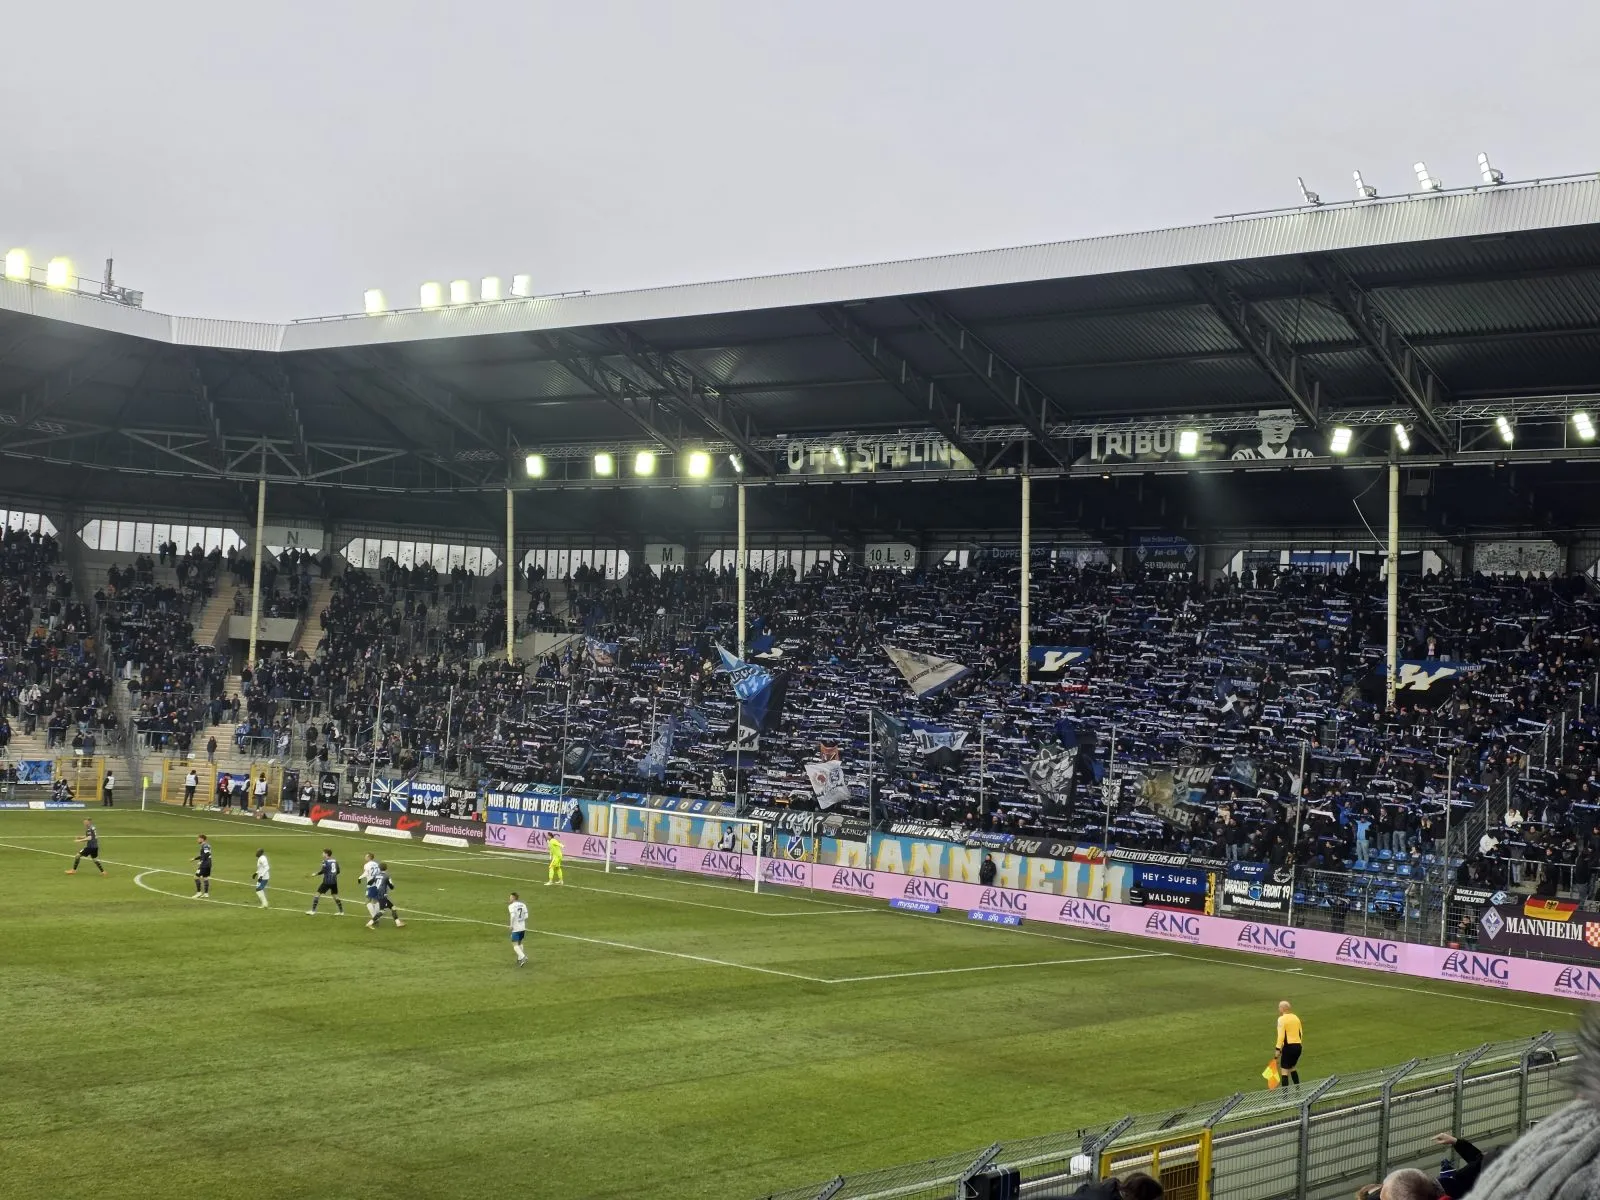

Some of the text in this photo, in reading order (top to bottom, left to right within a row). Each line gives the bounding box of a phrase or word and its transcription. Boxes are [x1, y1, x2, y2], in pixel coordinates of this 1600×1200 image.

[287, 530, 299, 545] N
[662, 547, 673, 561] M
[870, 547, 911, 563] 10 L 9
[411, 794, 423, 805] 19
[488, 793, 504, 808] NUR
[506, 794, 520, 810] FÜR
[522, 796, 539, 812] DEN
[410, 807, 440, 817] WALDHO
[425, 822, 483, 838] Familienbäckerei
[488, 825, 506, 842] NG
[640, 844, 677, 863] RNG
[701, 851, 739, 871] RNG
[1112, 848, 1188, 866] KOLLEKTIV SECHS ACHT
[766, 860, 805, 880] RNG
[832, 868, 874, 890] RNG
[1142, 871, 1159, 882] HEY
[1167, 874, 1198, 886] SUPER
[904, 877, 948, 900] RNG
[897, 900, 930, 911] myspa.me
[979, 887, 1027, 911] RNG
[1148, 892, 1191, 905] WALDHOF
[517, 907, 523, 919] 7
[1059, 898, 1110, 923] RNG
[1145, 910, 1200, 936] RNG
[1505, 916, 1584, 942] MANNHEIM
[1238, 923, 1296, 949] RNG
[1336, 936, 1398, 964] RNG
[1442, 951, 1509, 980] RNG
[1441, 971, 1509, 986] Rhein-Neckar-Gleisbau
[1554, 966, 1600, 991] RN
[1554, 987, 1600, 998] Rhein-Neckar-
